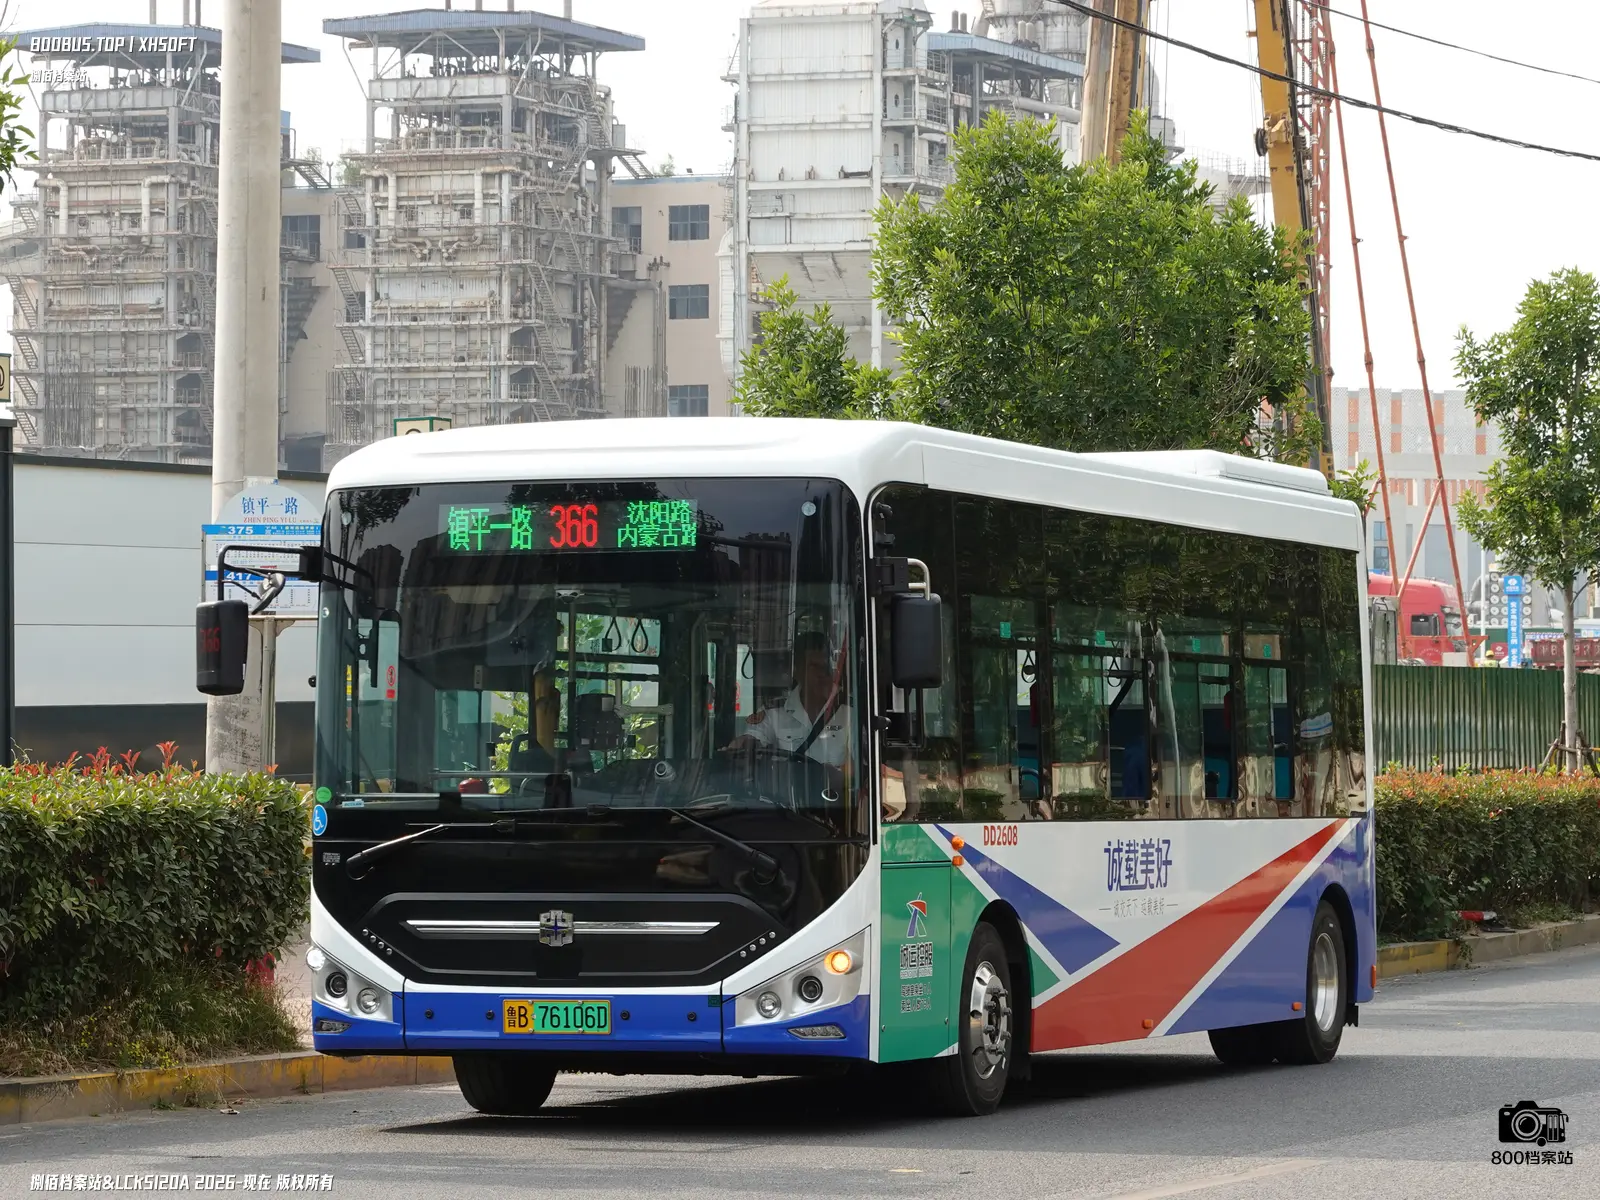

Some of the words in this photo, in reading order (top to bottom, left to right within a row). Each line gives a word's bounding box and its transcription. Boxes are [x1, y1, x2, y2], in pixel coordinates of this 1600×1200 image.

[241, 496, 298, 515] 镇平一路
[626, 500, 693, 525] 沈阳路
[227, 525, 254, 535] 375
[243, 516, 262, 524] ZHEN
[262, 516, 279, 524] PING
[447, 503, 534, 551] 镇平一路
[549, 504, 598, 549] 366
[616, 522, 697, 549] 内蒙古路
[226, 570, 252, 580] 417
[983, 825, 1018, 846] DD2608
[1103, 838, 1173, 892] 诚载美好
